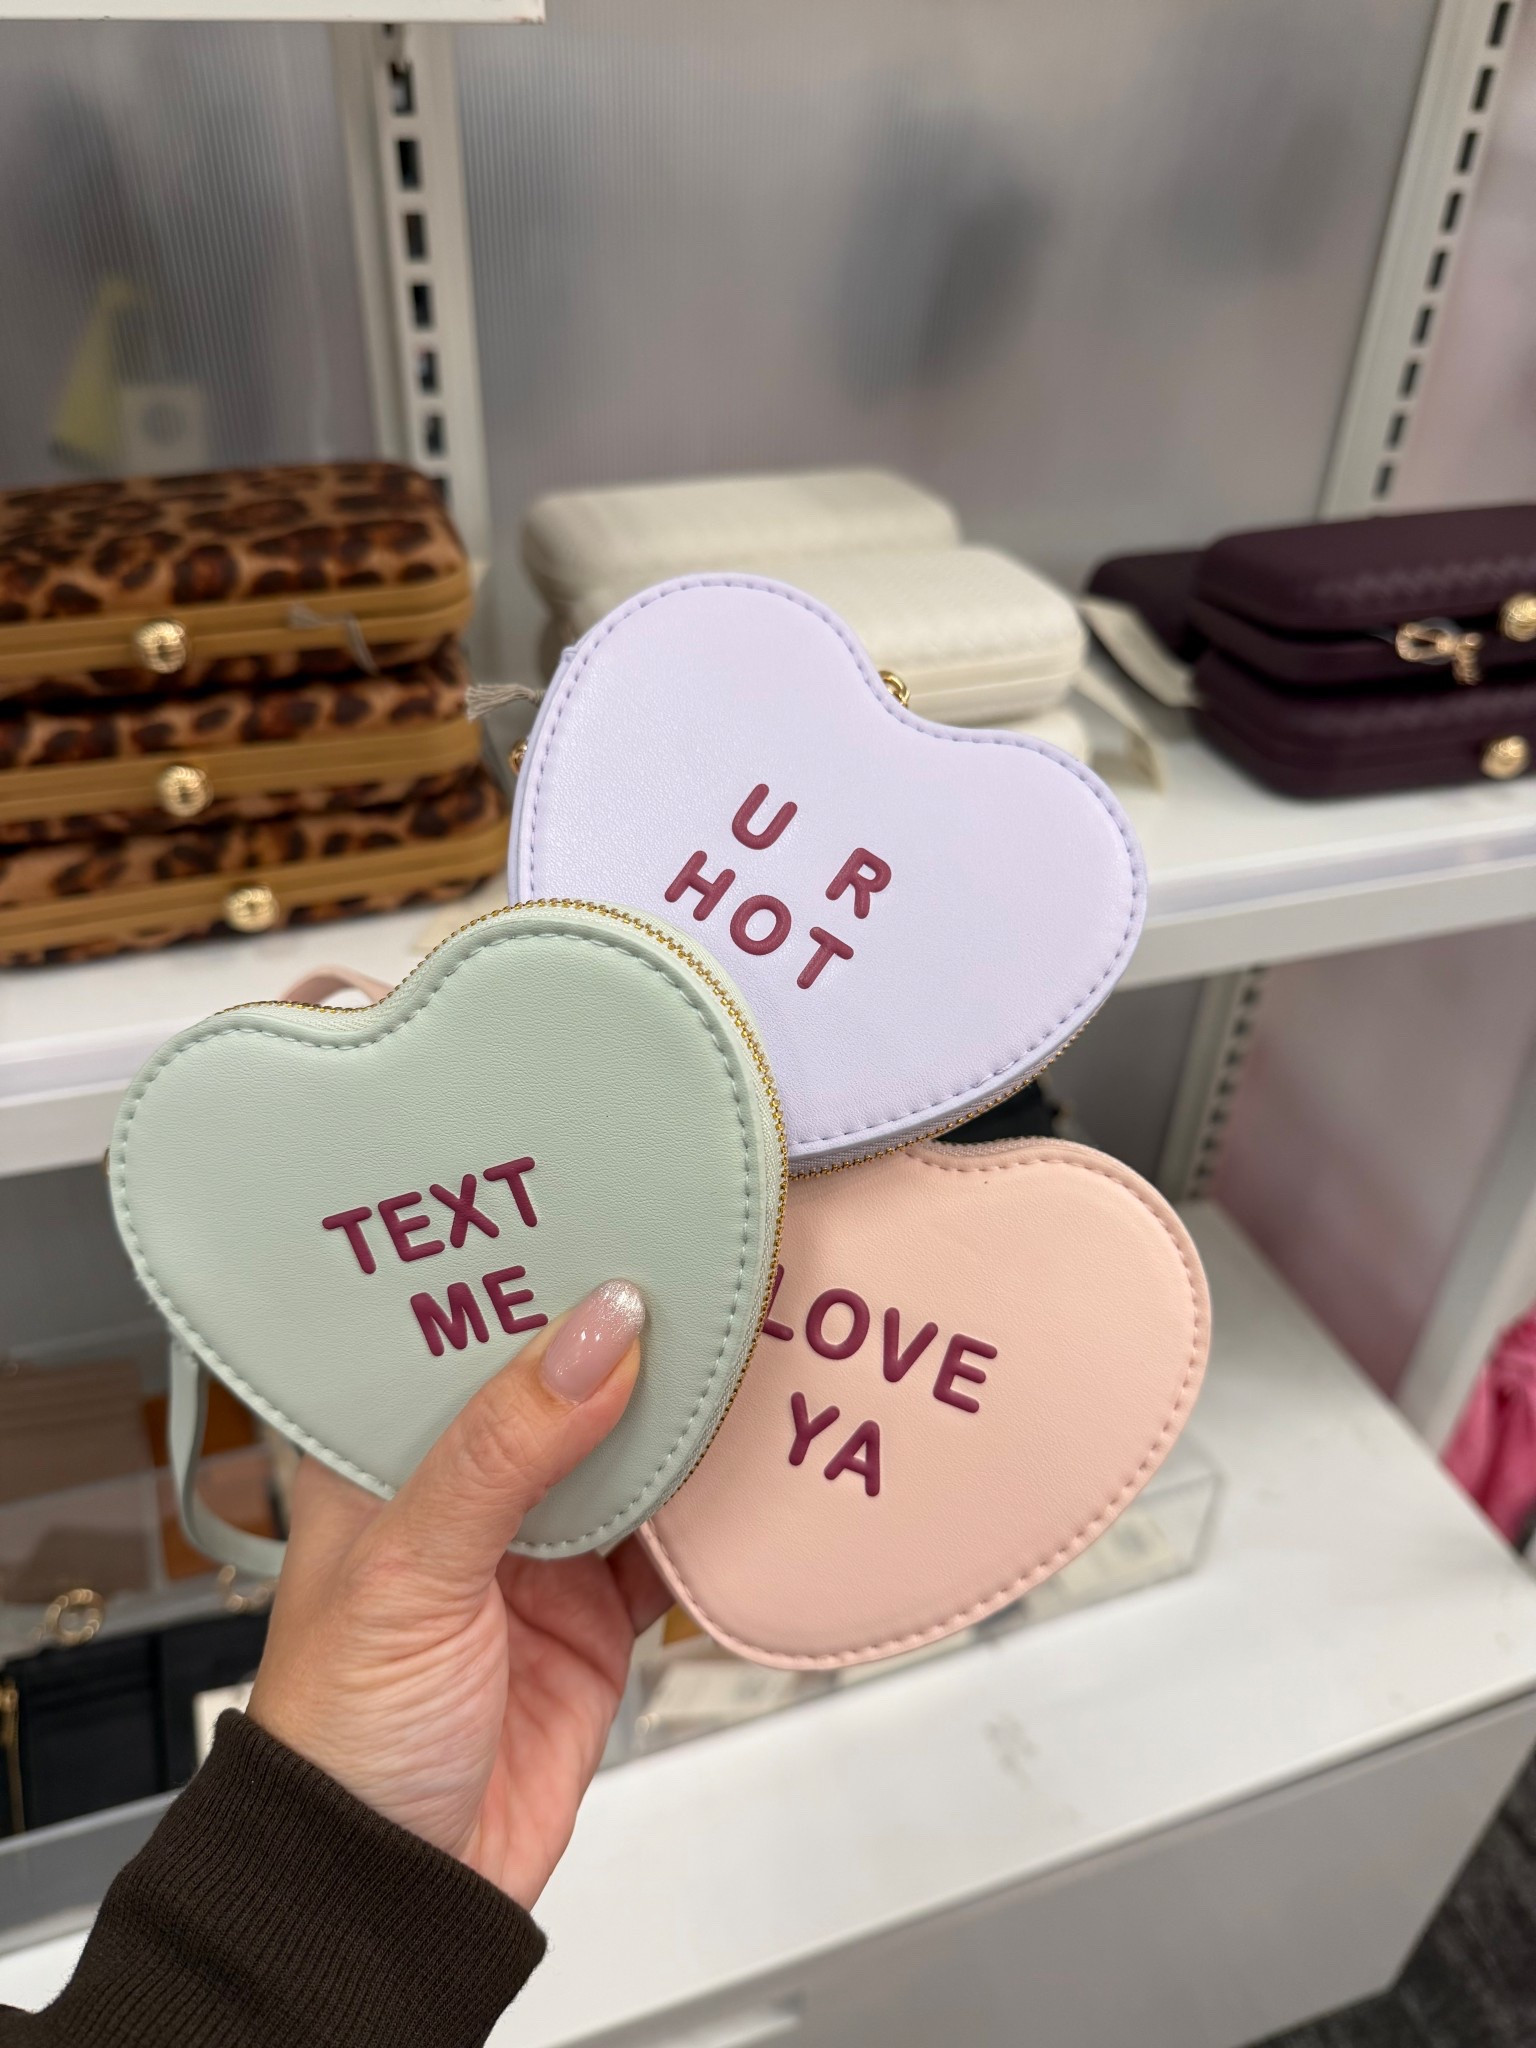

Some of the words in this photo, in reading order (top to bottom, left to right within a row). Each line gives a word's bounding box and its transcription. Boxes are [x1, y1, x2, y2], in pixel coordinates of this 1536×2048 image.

[731, 782, 798, 851] U
[825, 846, 893, 919] R
[664, 850, 855, 990] HOT
[322, 1156, 538, 1275] TEXT
[410, 1265, 549, 1357] ME
[787, 1390, 882, 1498] YA
